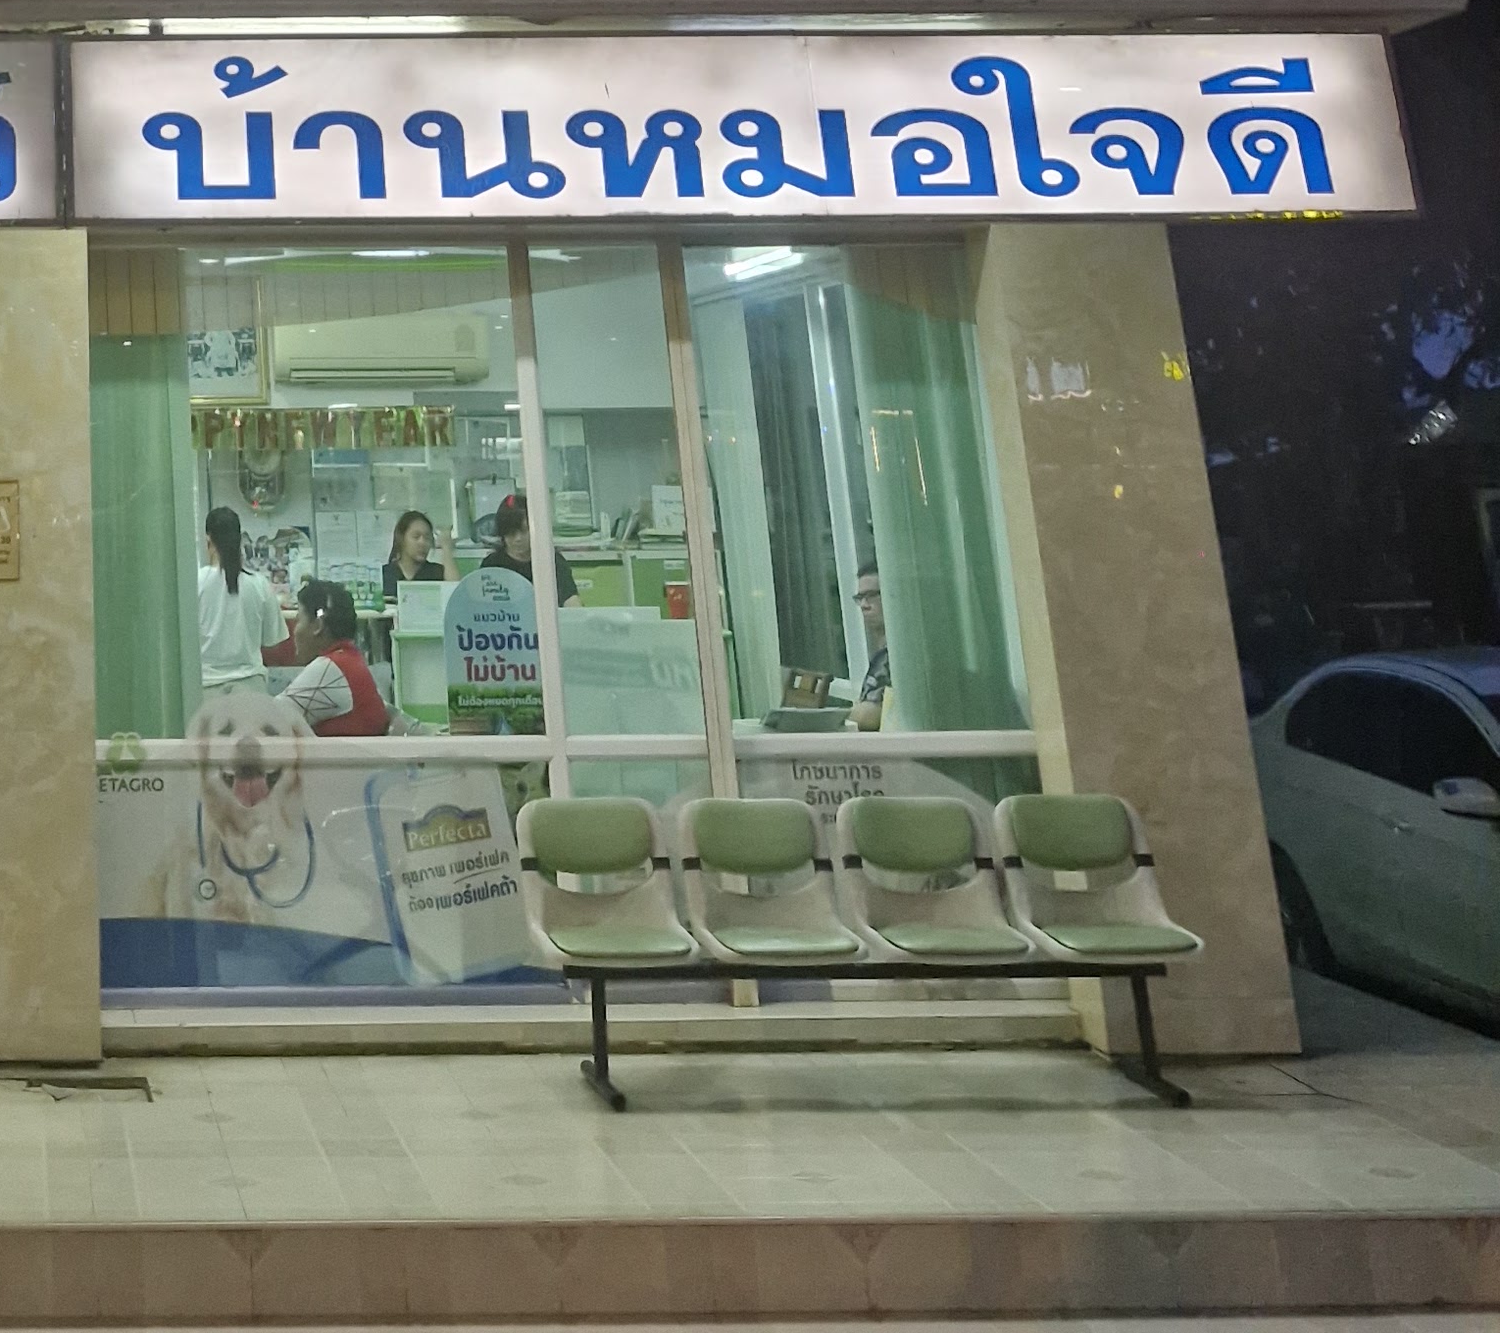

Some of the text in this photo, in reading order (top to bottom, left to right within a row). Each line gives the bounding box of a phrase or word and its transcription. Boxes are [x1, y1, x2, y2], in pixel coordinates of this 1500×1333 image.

[141, 55, 1335, 201] บ้านหมอใจดี
[474, 610, 520, 622] แมวบ้าน
[456, 624, 539, 652] ป้องกัน
[464, 656, 537, 682] ไม่บ้าน
[408, 822, 488, 849] Perfecta
